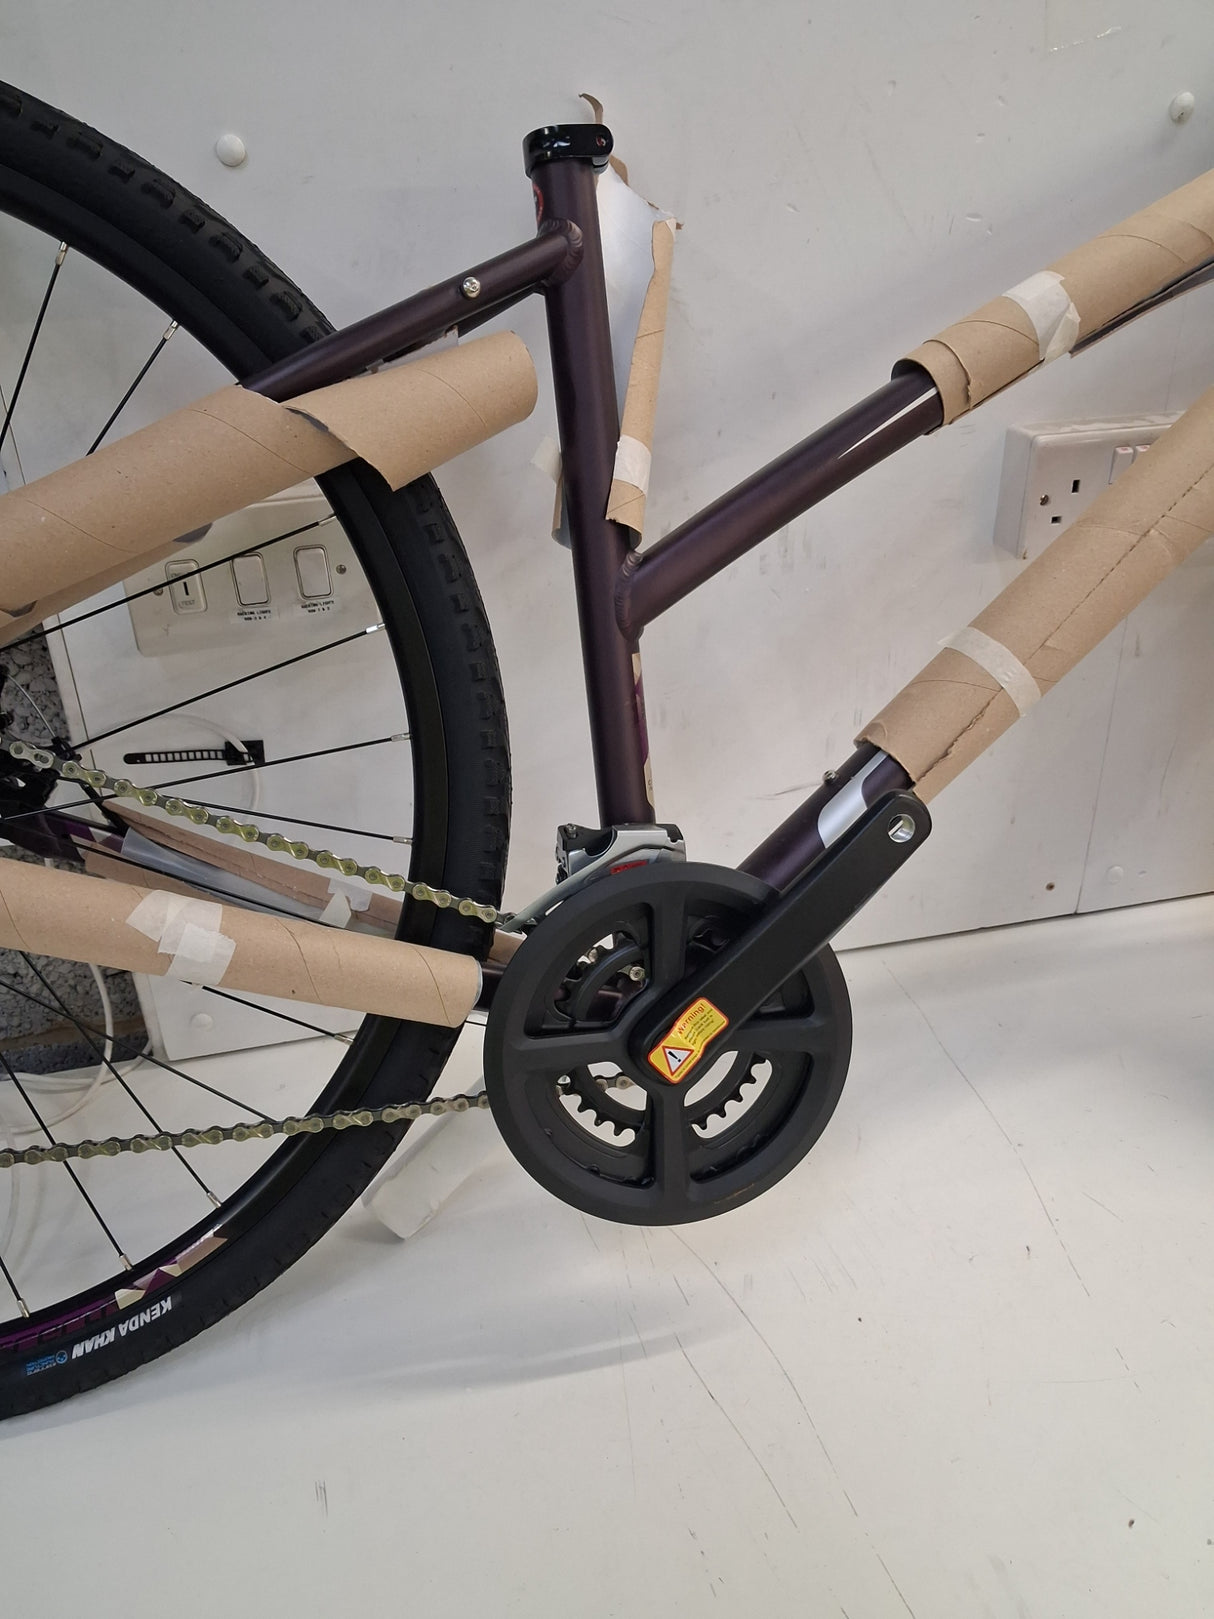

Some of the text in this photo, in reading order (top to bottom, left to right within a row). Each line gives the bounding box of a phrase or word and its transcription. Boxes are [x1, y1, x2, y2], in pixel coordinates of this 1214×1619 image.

[677, 1003, 706, 1035] Warning!
[72, 1296, 172, 1359] KENDA KHAN
